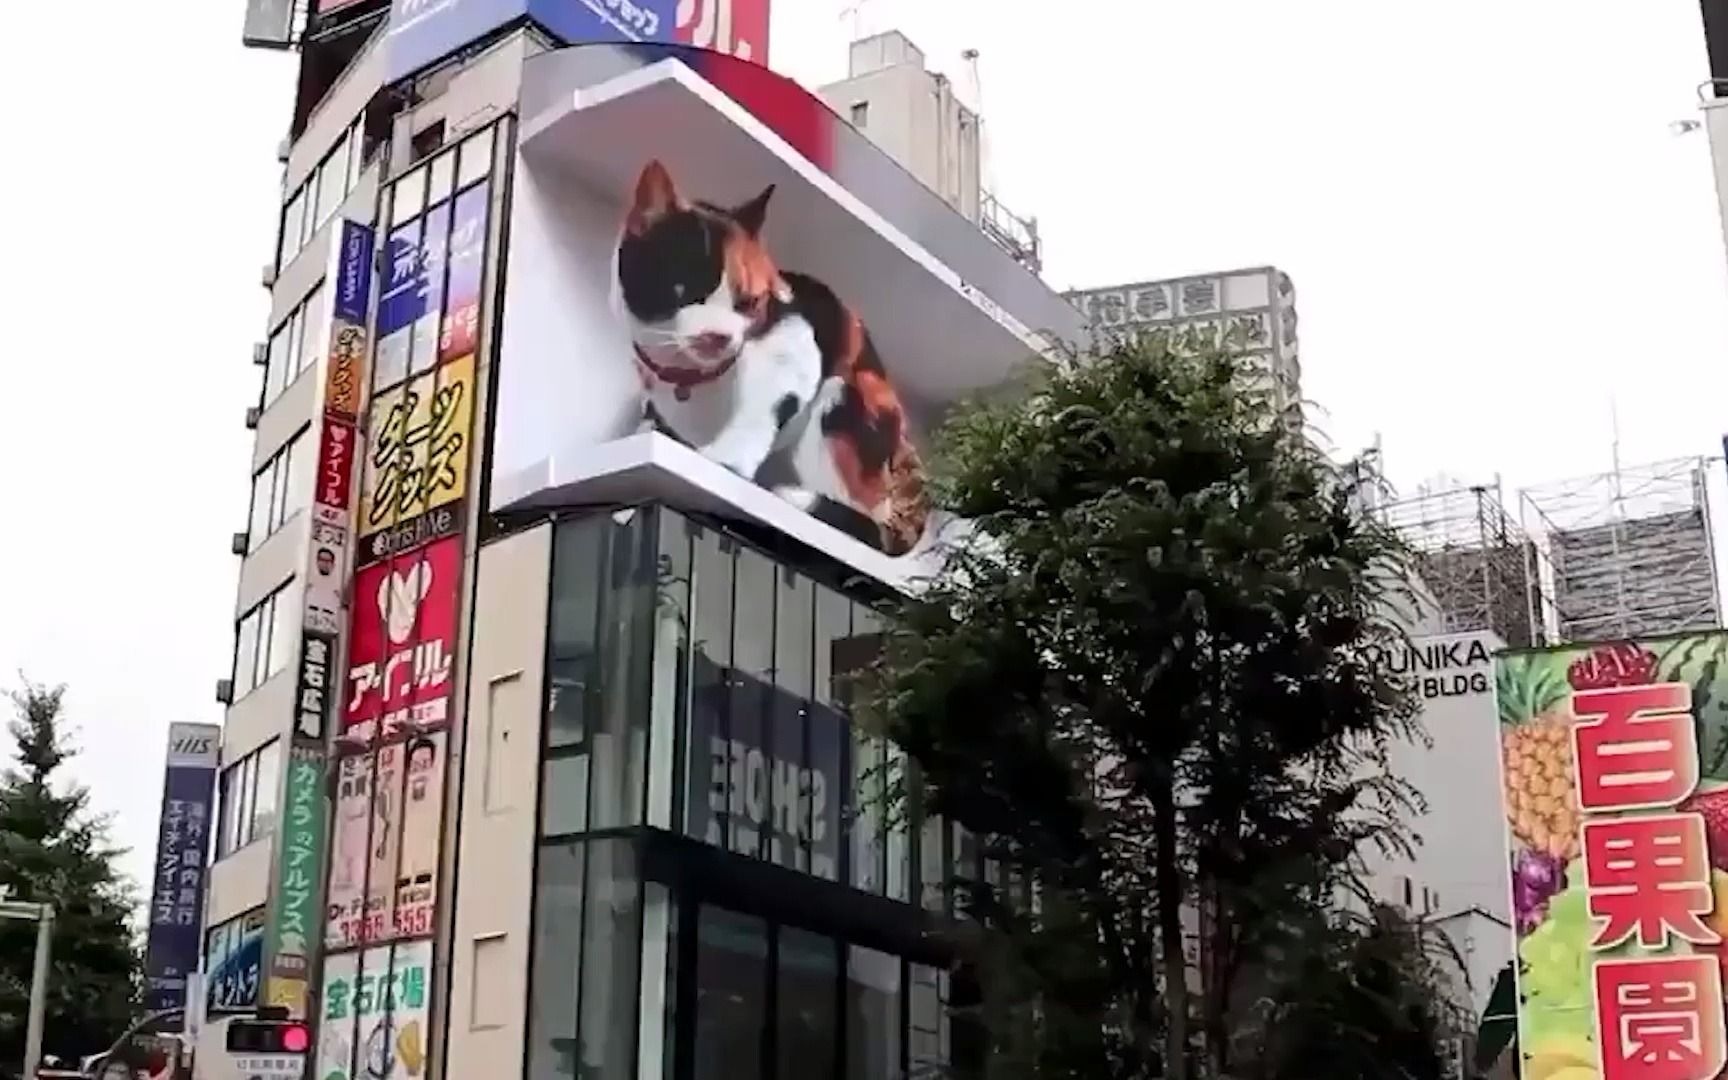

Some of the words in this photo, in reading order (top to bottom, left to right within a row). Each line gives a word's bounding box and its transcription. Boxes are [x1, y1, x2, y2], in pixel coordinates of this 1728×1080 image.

[349, 638, 452, 712] アイフル
[1570, 683, 1727, 1080] 百果園
